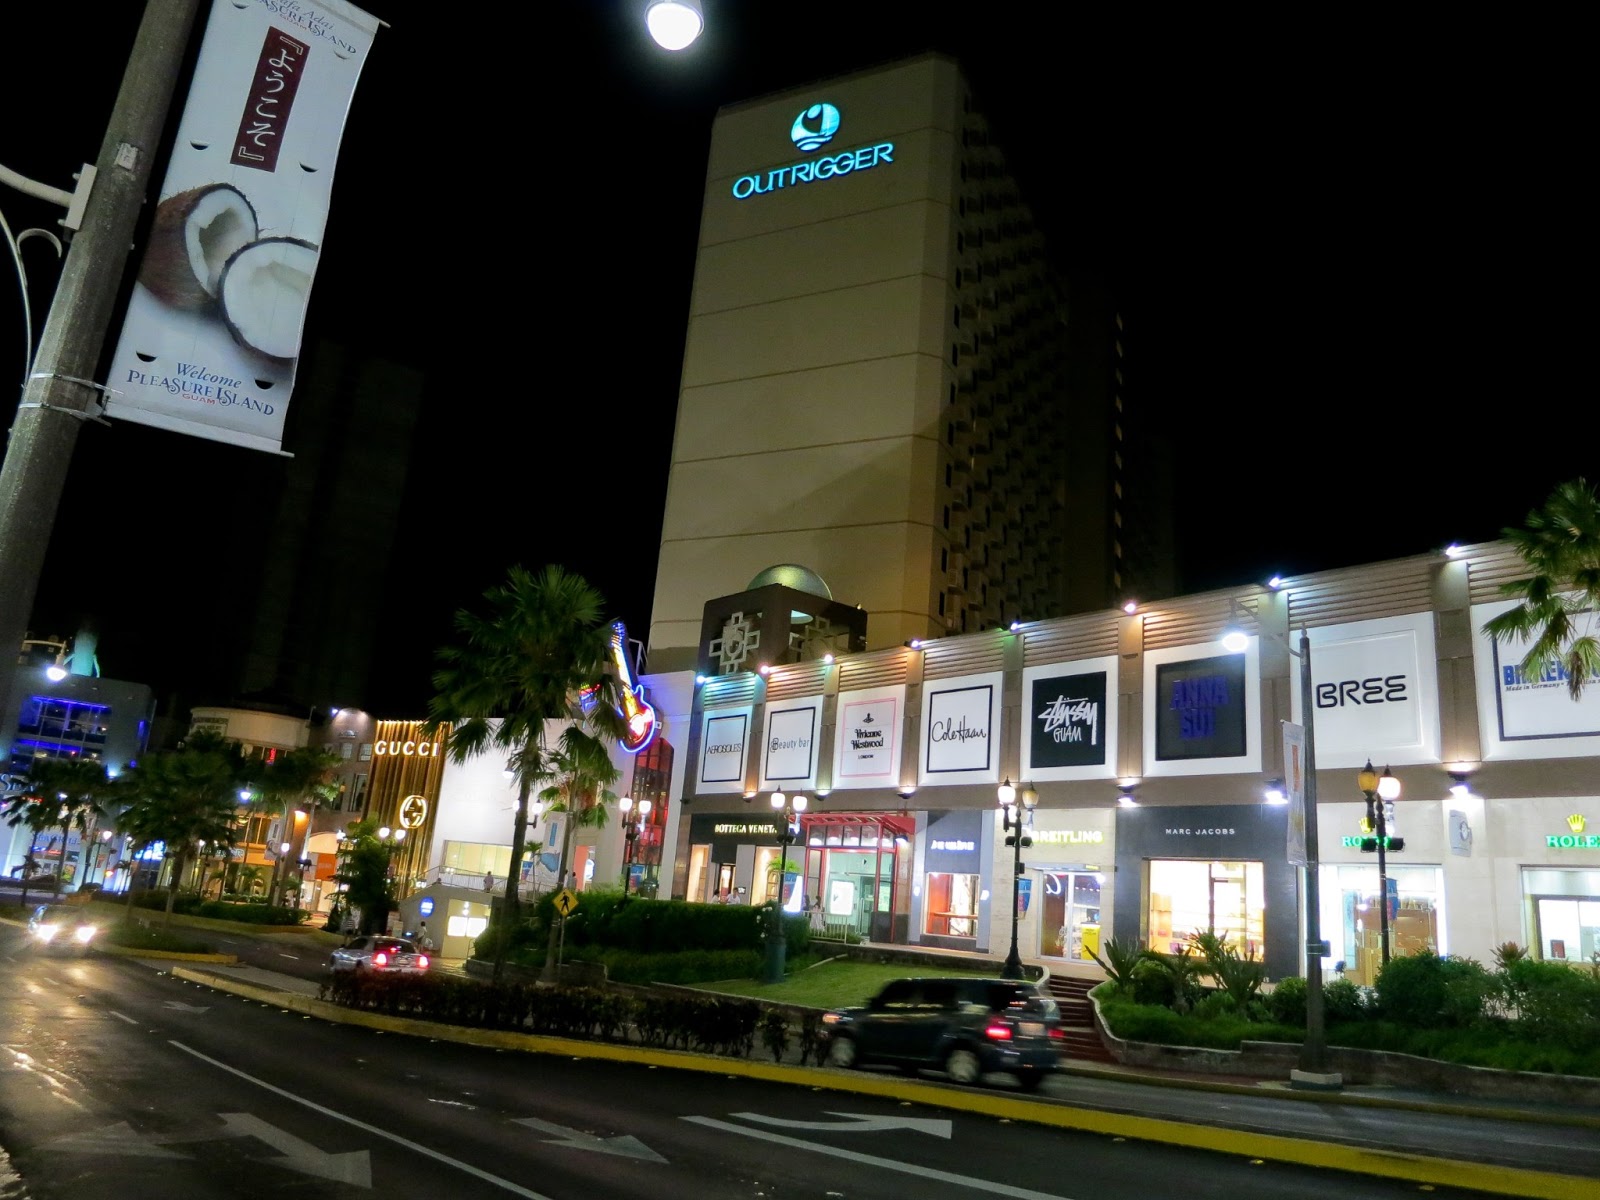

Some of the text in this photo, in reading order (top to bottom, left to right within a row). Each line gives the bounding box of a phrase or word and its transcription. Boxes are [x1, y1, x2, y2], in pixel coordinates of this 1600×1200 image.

[308, 20, 357, 54] ISLAND
[732, 142, 894, 199] OUTRIGGER
[177, 362, 242, 389] Welcome
[126, 369, 274, 416] PLEASURE ISLAND
[182, 393, 216, 405] GUAM
[1170, 675, 1230, 711] ANNA
[1316, 674, 1408, 709] BREE
[931, 717, 957, 742] Cole
[1179, 707, 1216, 740] SUI
[798, 737, 810, 748] bar
[854, 728, 882, 739] Vivienne
[1053, 725, 1082, 743] GUAM
[374, 740, 440, 757] GUCCI
[706, 742, 742, 754] AEROSOLES
[851, 737, 884, 750] Westwood
[714, 823, 747, 834] BOTTEGA
[1545, 835, 1600, 849] ROLE
